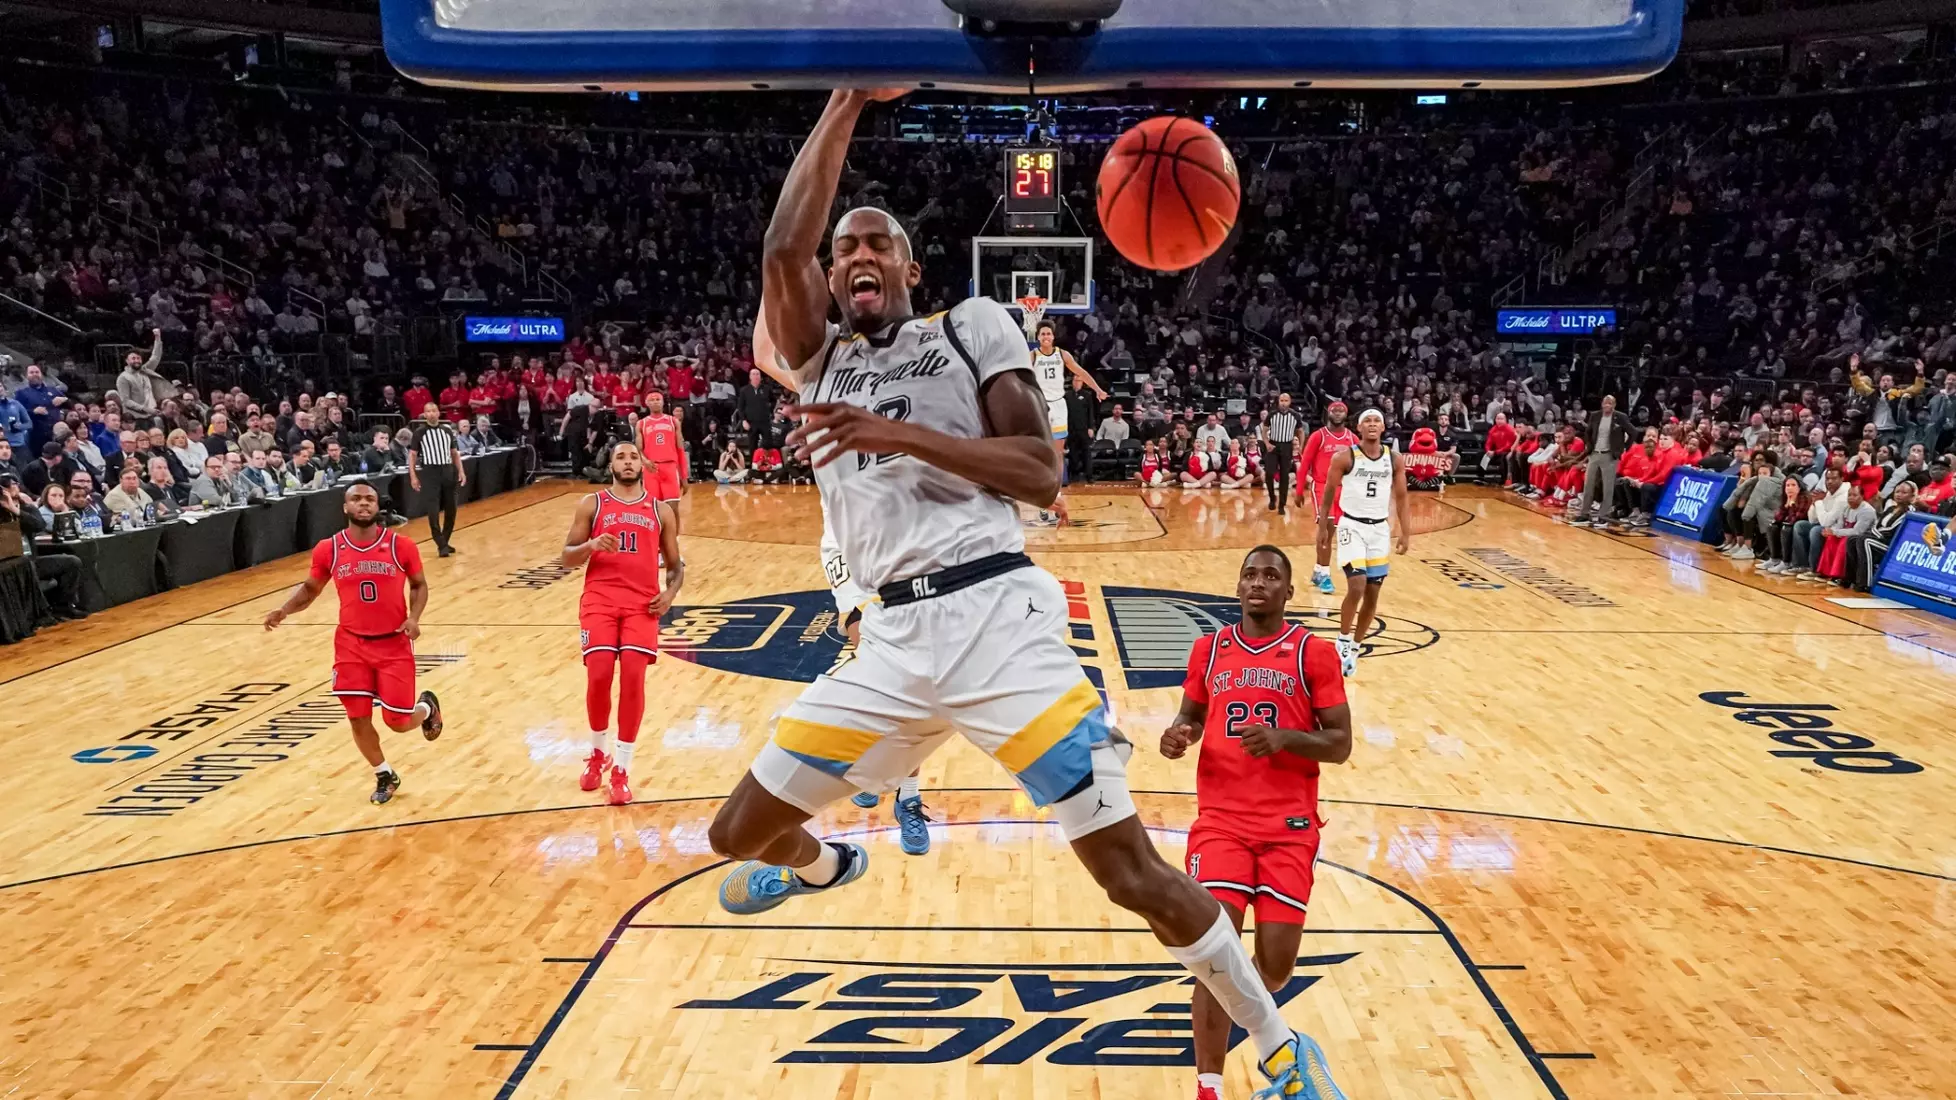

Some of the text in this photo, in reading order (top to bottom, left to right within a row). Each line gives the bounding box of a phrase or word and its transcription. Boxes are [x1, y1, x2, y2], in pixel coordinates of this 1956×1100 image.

[1016, 153, 1053, 170] 15:18
[1016, 169, 1049, 196] 27
[472, 323, 558, 335] Michelob ULTRA
[1504, 315, 1606, 329] Michelob ULTRA
[828, 348, 950, 403] Marquette
[1044, 366, 1057, 380] 13
[655, 431, 666, 446] 2
[1366, 481, 1378, 498] 5
[1675, 475, 1715, 505] SAMUEL
[1667, 497, 1704, 522] ADAMS
[618, 530, 638, 554] 11
[1895, 540, 1943, 571] OFFICIAL
[360, 580, 378, 603] 0
[911, 576, 937, 598] AL
[1213, 667, 1297, 697] ST. JOHN'S
[117, 682, 291, 741] CHASE
[1225, 700, 1280, 739] 23
[1698, 690, 1925, 774] Jeep
[82, 753, 290, 817] GARDEN
[772, 1016, 1252, 1067] BIG
